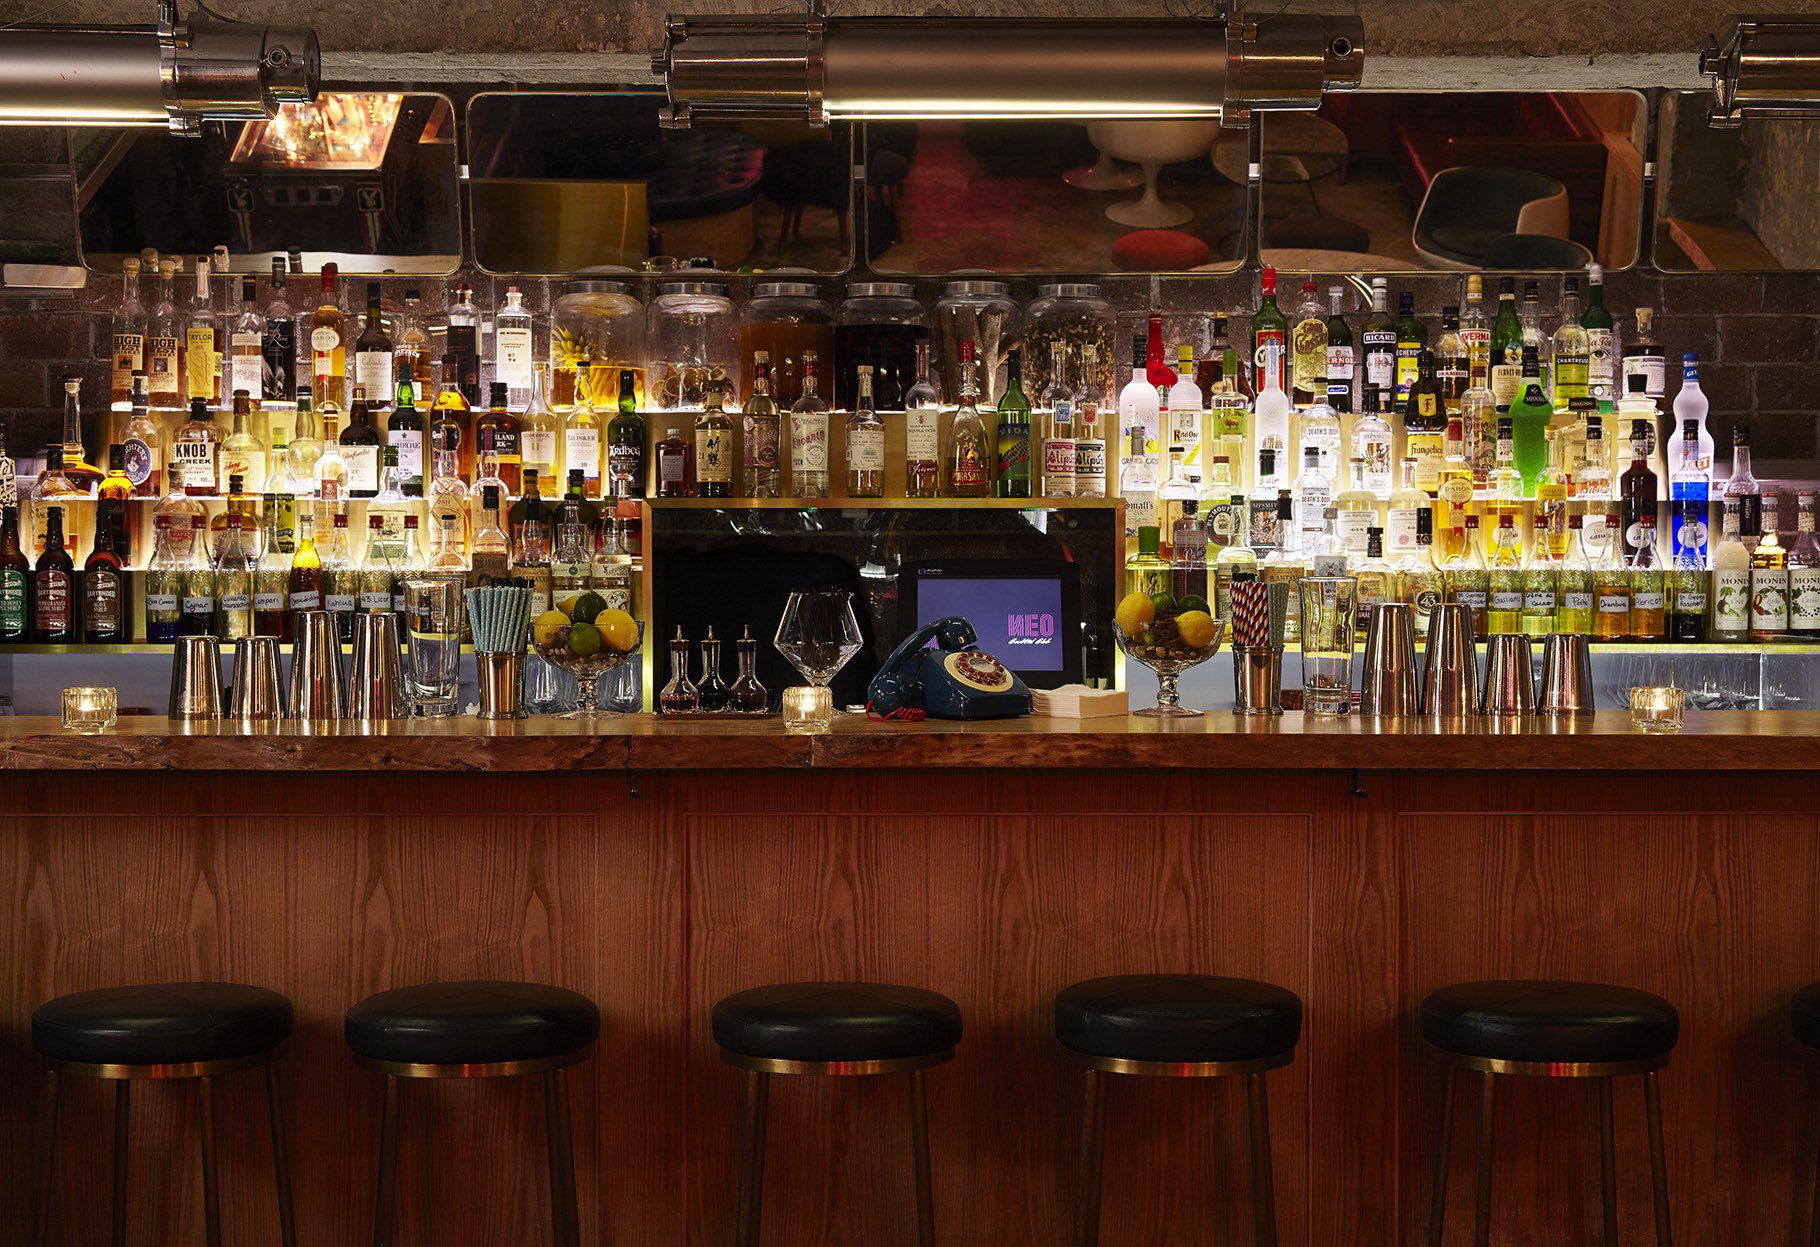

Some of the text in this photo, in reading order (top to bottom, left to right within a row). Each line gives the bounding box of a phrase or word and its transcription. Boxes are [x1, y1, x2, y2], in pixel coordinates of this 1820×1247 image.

[114, 335, 141, 345] HIGH
[188, 333, 213, 341] TAYLOR
[1366, 334, 1395, 342] RICARD
[1000, 427, 1029, 436] VIDA
[176, 443, 207, 458] KNOB
[609, 444, 642, 458] Ardbeg
[1125, 501, 1154, 510] Small's
[1252, 501, 1278, 509] SIPSMIT
[1420, 595, 1436, 606] 43
[1494, 595, 1521, 605] Galliano
[185, 600, 208, 613] Cynar
[1008, 613, 1054, 637] NEO
